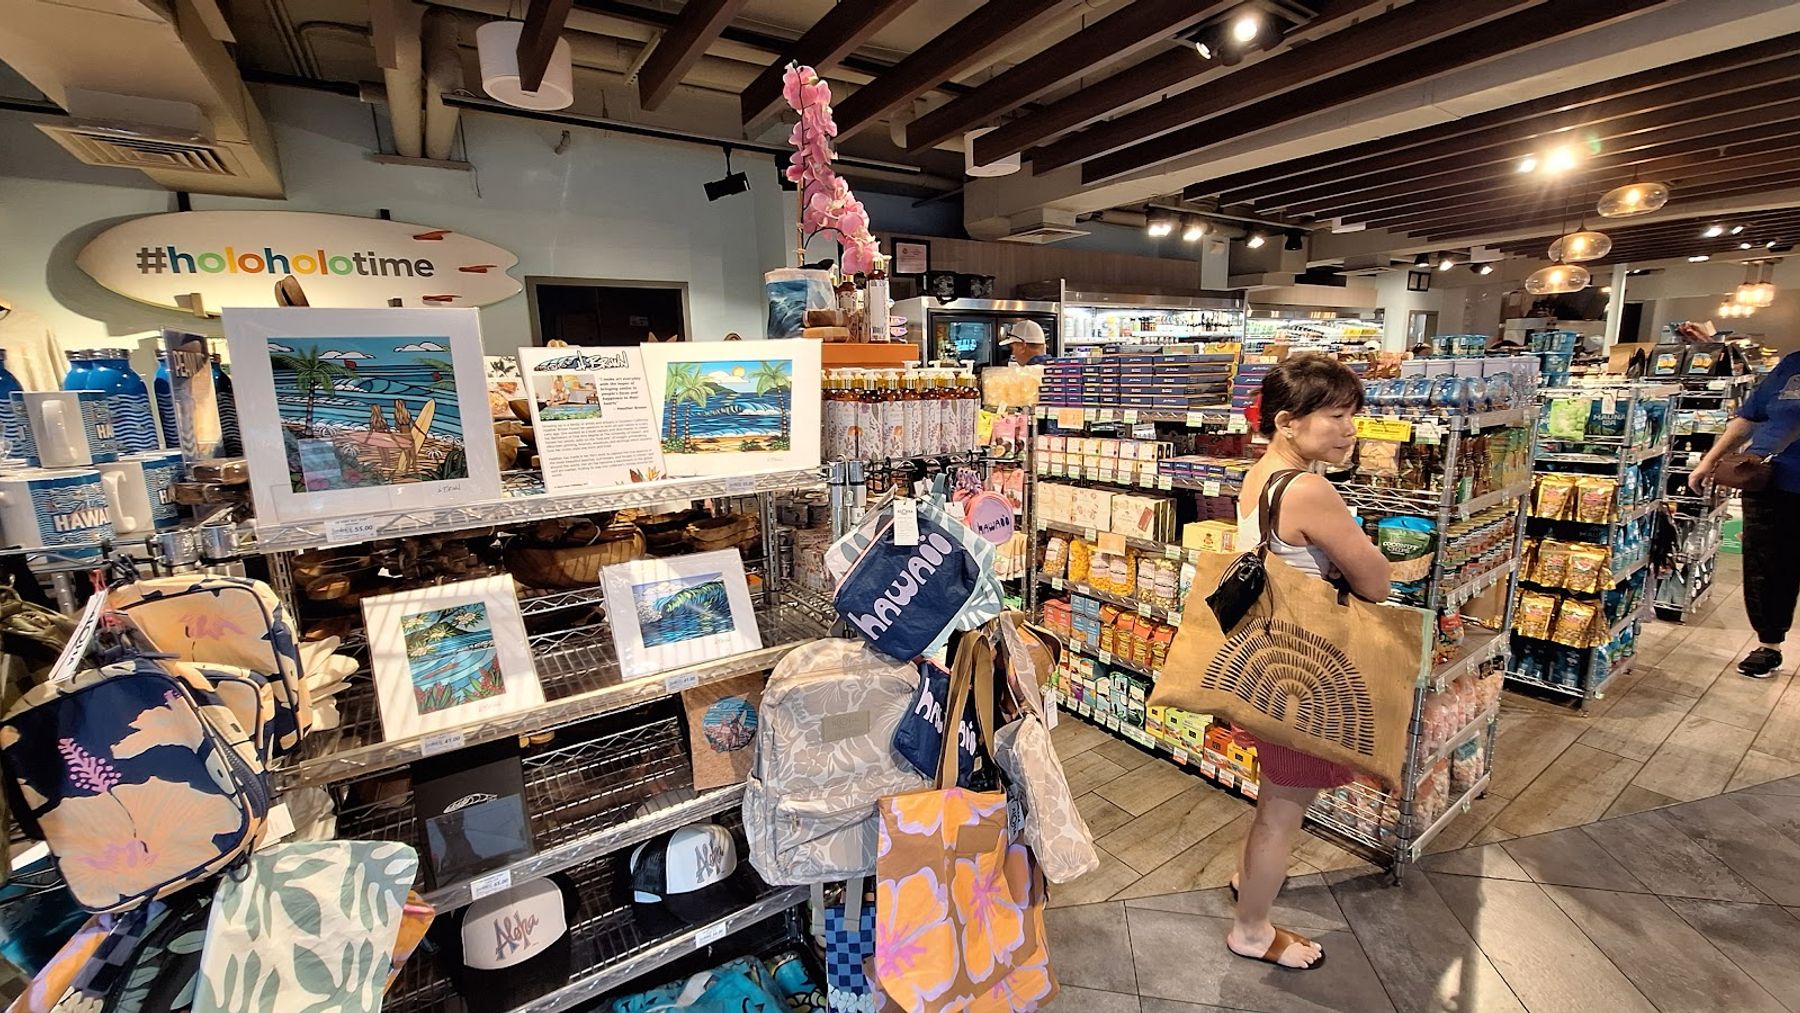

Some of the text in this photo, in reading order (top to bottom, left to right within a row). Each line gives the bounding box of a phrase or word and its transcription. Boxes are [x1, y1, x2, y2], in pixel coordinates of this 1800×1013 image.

[136, 245, 435, 278] #holoholotime
[53, 507, 111, 532] HAWA
[493, 910, 539, 961] Aloha
